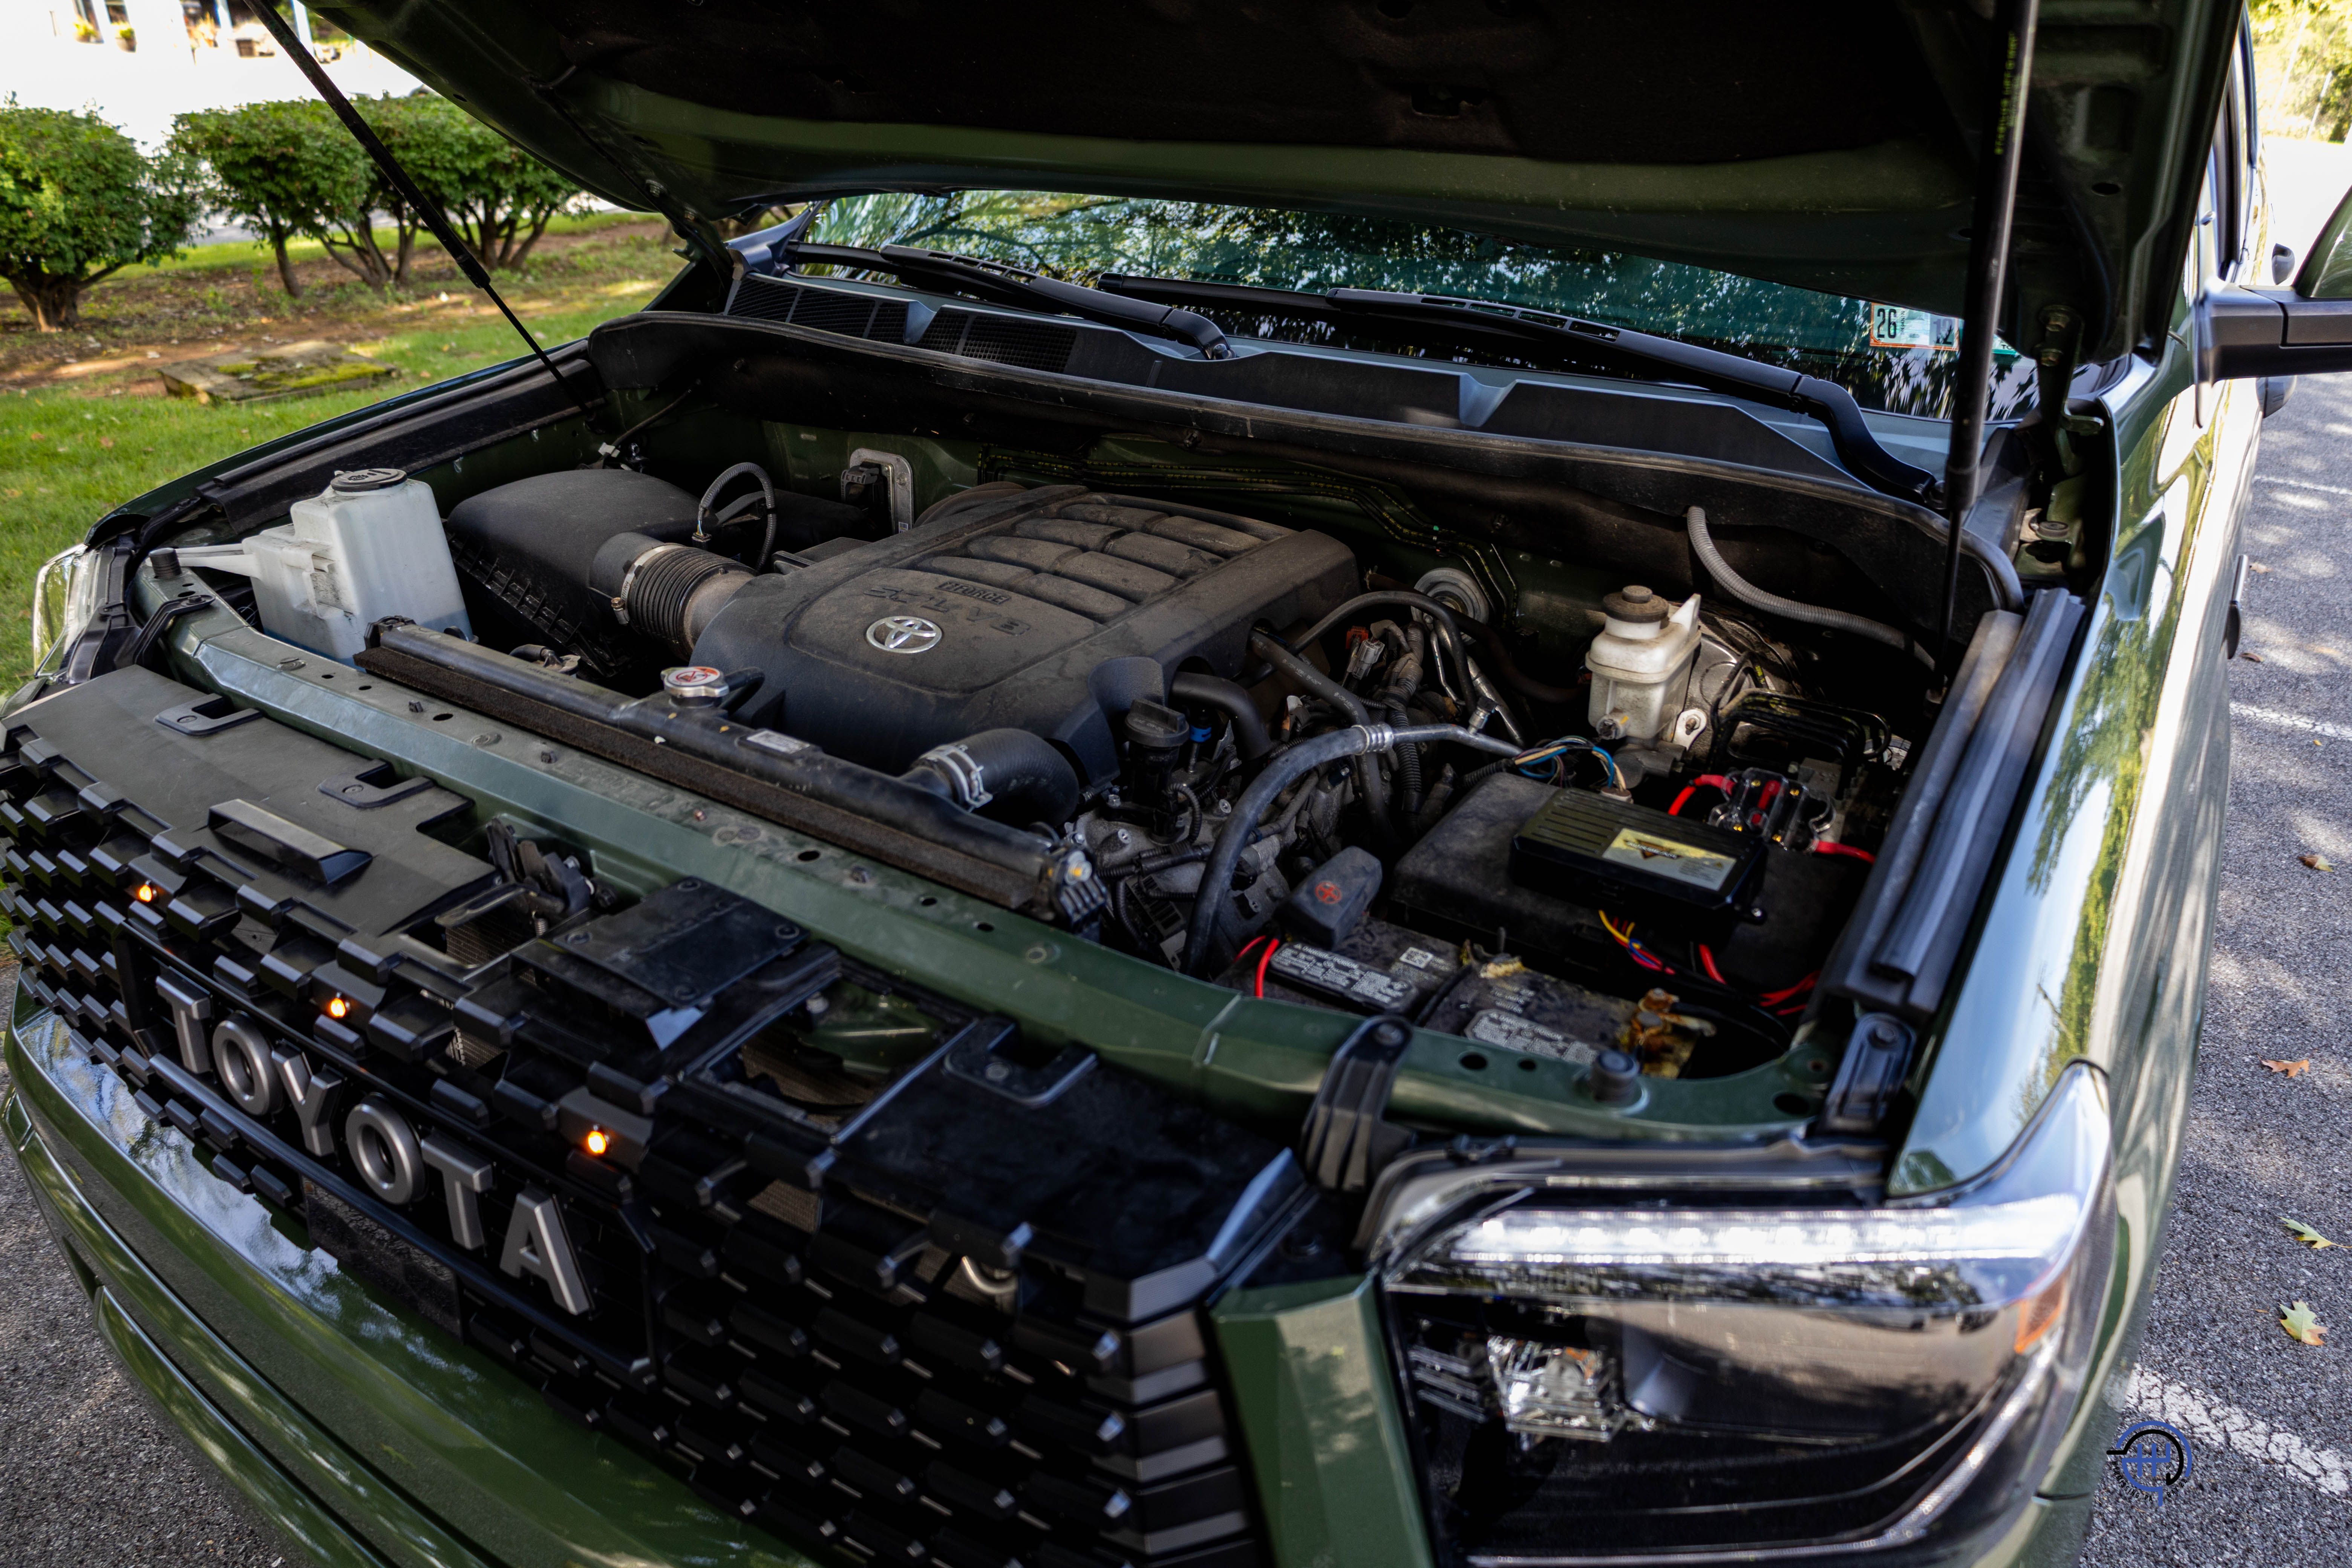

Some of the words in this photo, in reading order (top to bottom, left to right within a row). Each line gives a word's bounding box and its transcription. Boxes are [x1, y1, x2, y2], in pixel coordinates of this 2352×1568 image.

[1877, 308, 1897, 339] 26
[1932, 318, 1954, 345] 12
[966, 606, 1032, 636] V8
[155, 972, 593, 1317] TOYOTA
